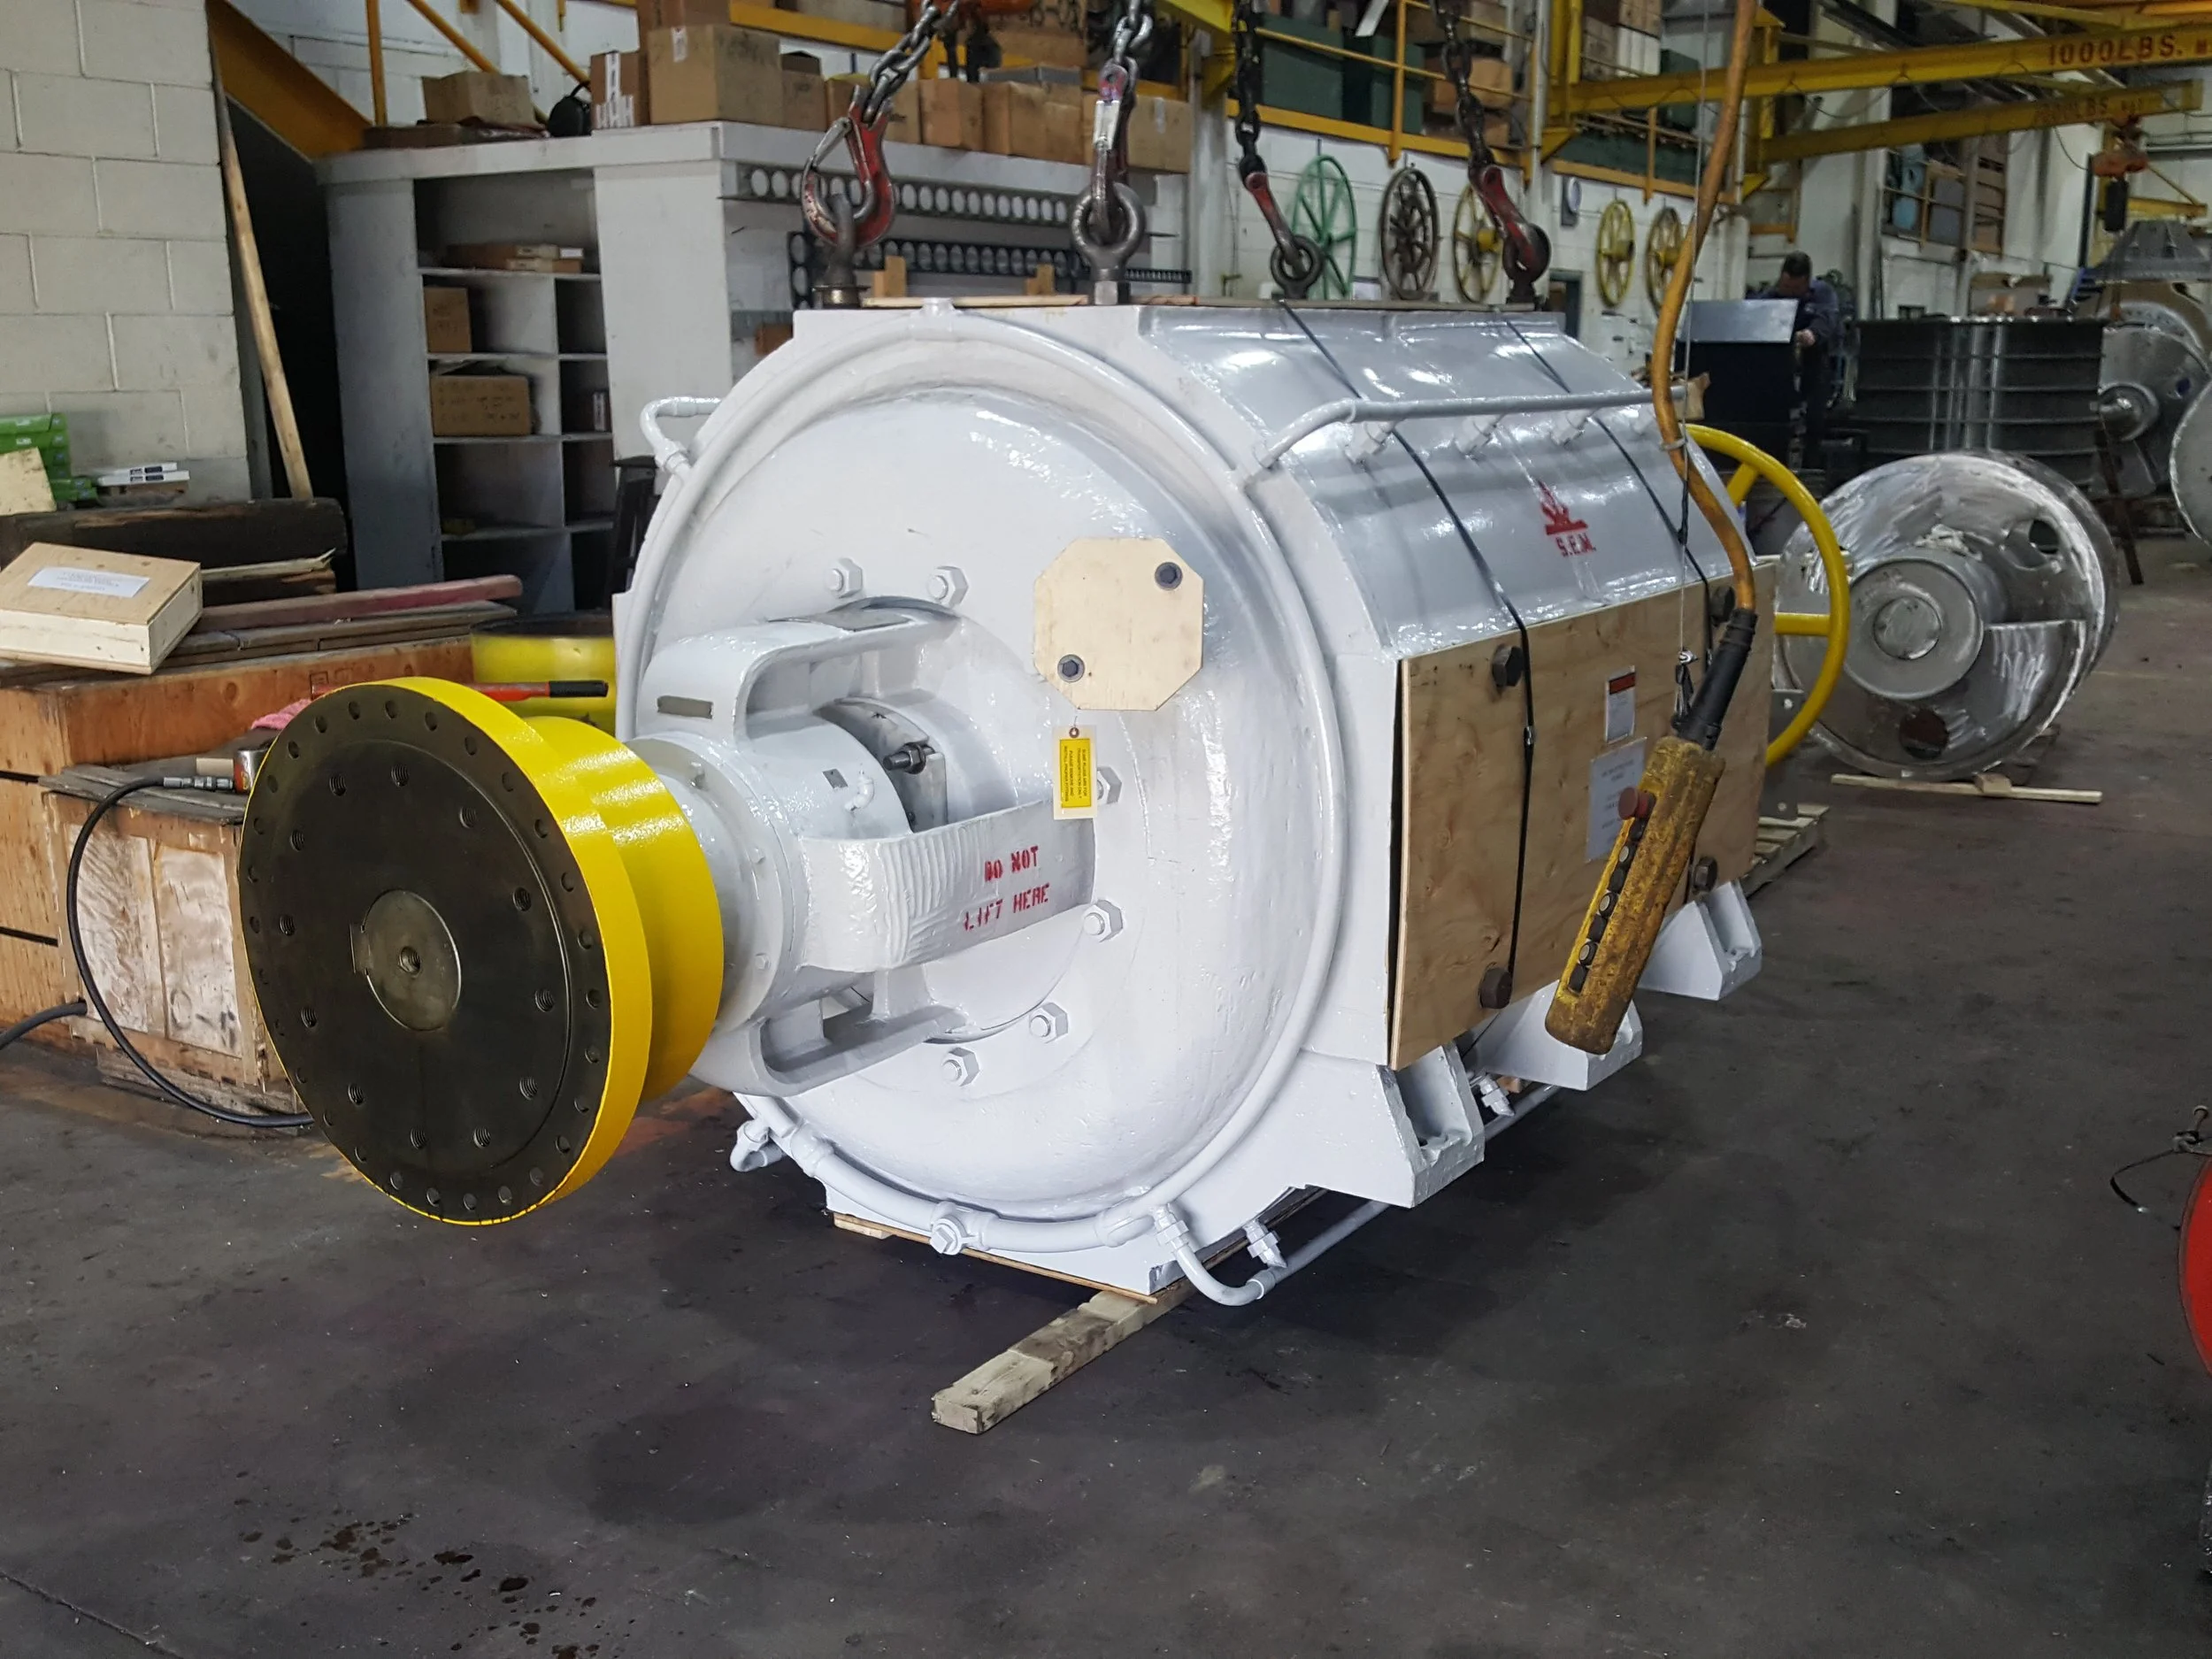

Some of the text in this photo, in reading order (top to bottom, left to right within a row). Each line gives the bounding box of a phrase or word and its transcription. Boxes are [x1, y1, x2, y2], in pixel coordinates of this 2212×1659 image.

[2049, 35, 2183, 65] 1000LBS.
[984, 845, 1039, 882] DO NOT
[964, 882, 1050, 932] LIFT HERE
